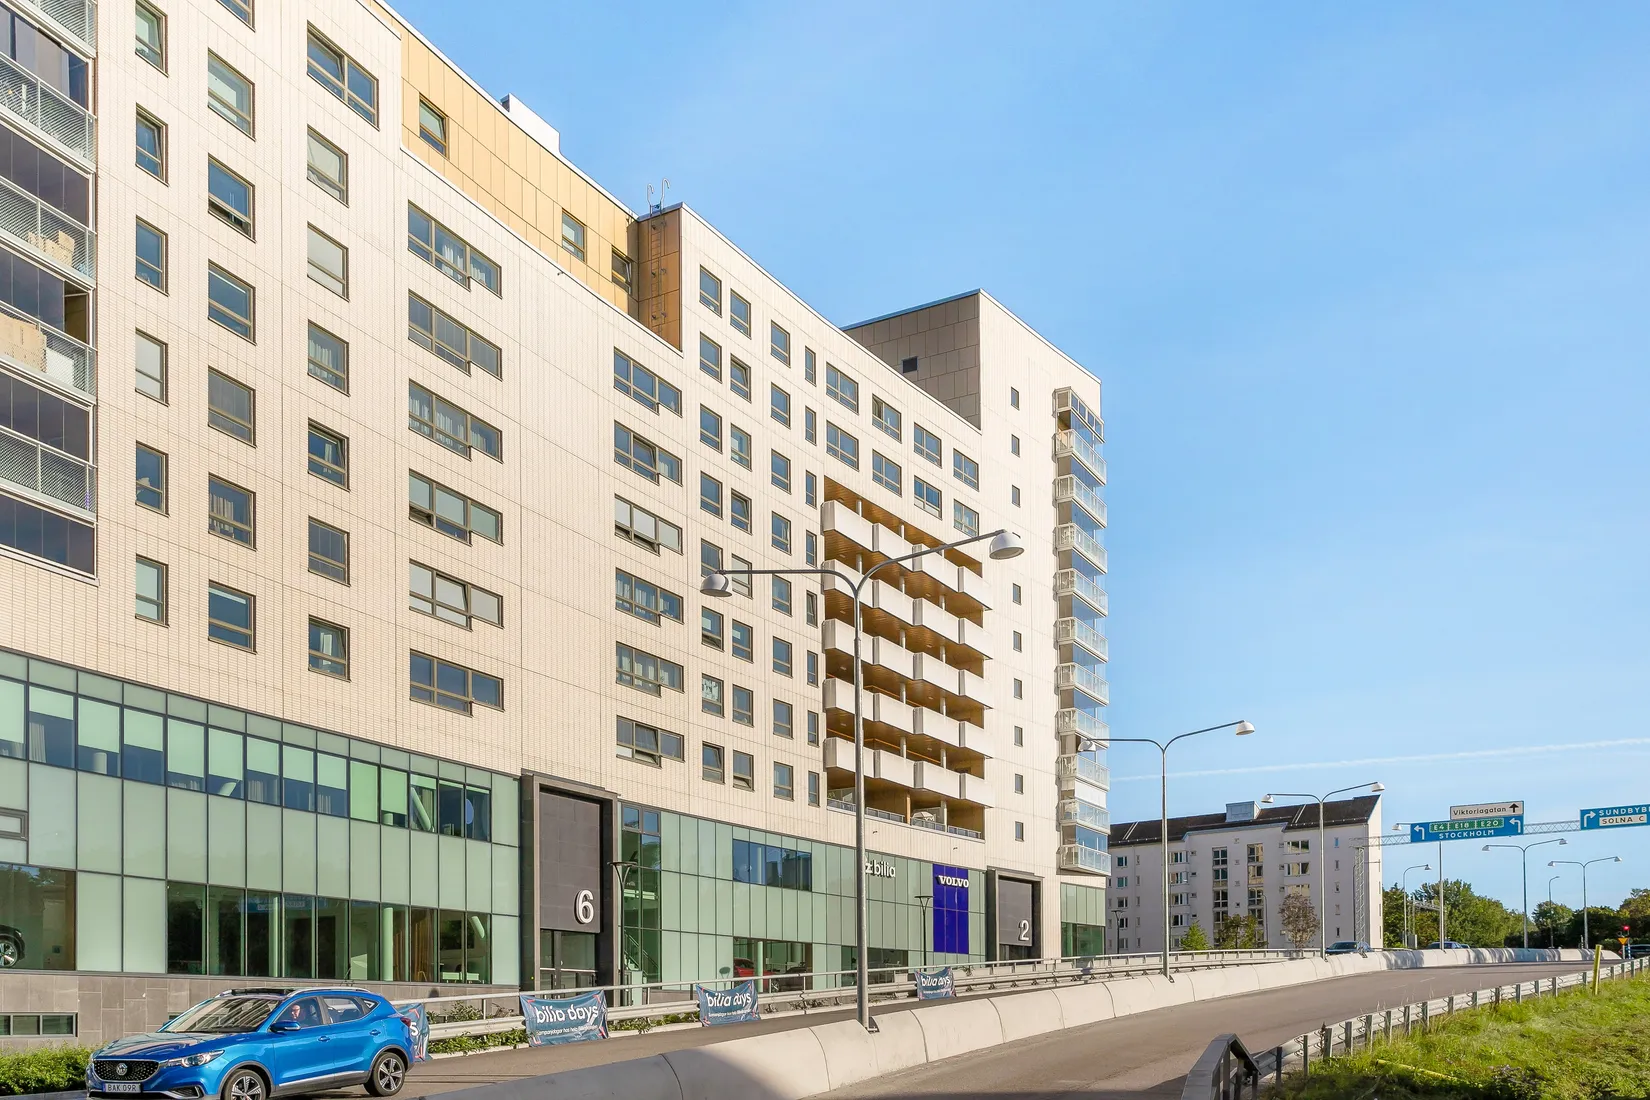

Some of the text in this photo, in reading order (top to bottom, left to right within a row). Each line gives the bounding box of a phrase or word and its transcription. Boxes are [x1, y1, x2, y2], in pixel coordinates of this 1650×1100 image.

[1453, 806, 1507, 816] Viktoriagatan
[1599, 806, 1650, 816] SUNDBYB
[1601, 816, 1633, 825] SOLNA
[1438, 829, 1495, 839] STOCKHOLM
[873, 859, 896, 878] bilia
[938, 874, 970, 888] VOLVO
[576, 889, 594, 924] 6
[1019, 919, 1030, 941] 2
[705, 992, 752, 1007] bilia days
[534, 1003, 599, 1024] bilia days
[107, 1083, 122, 1092] BAK
